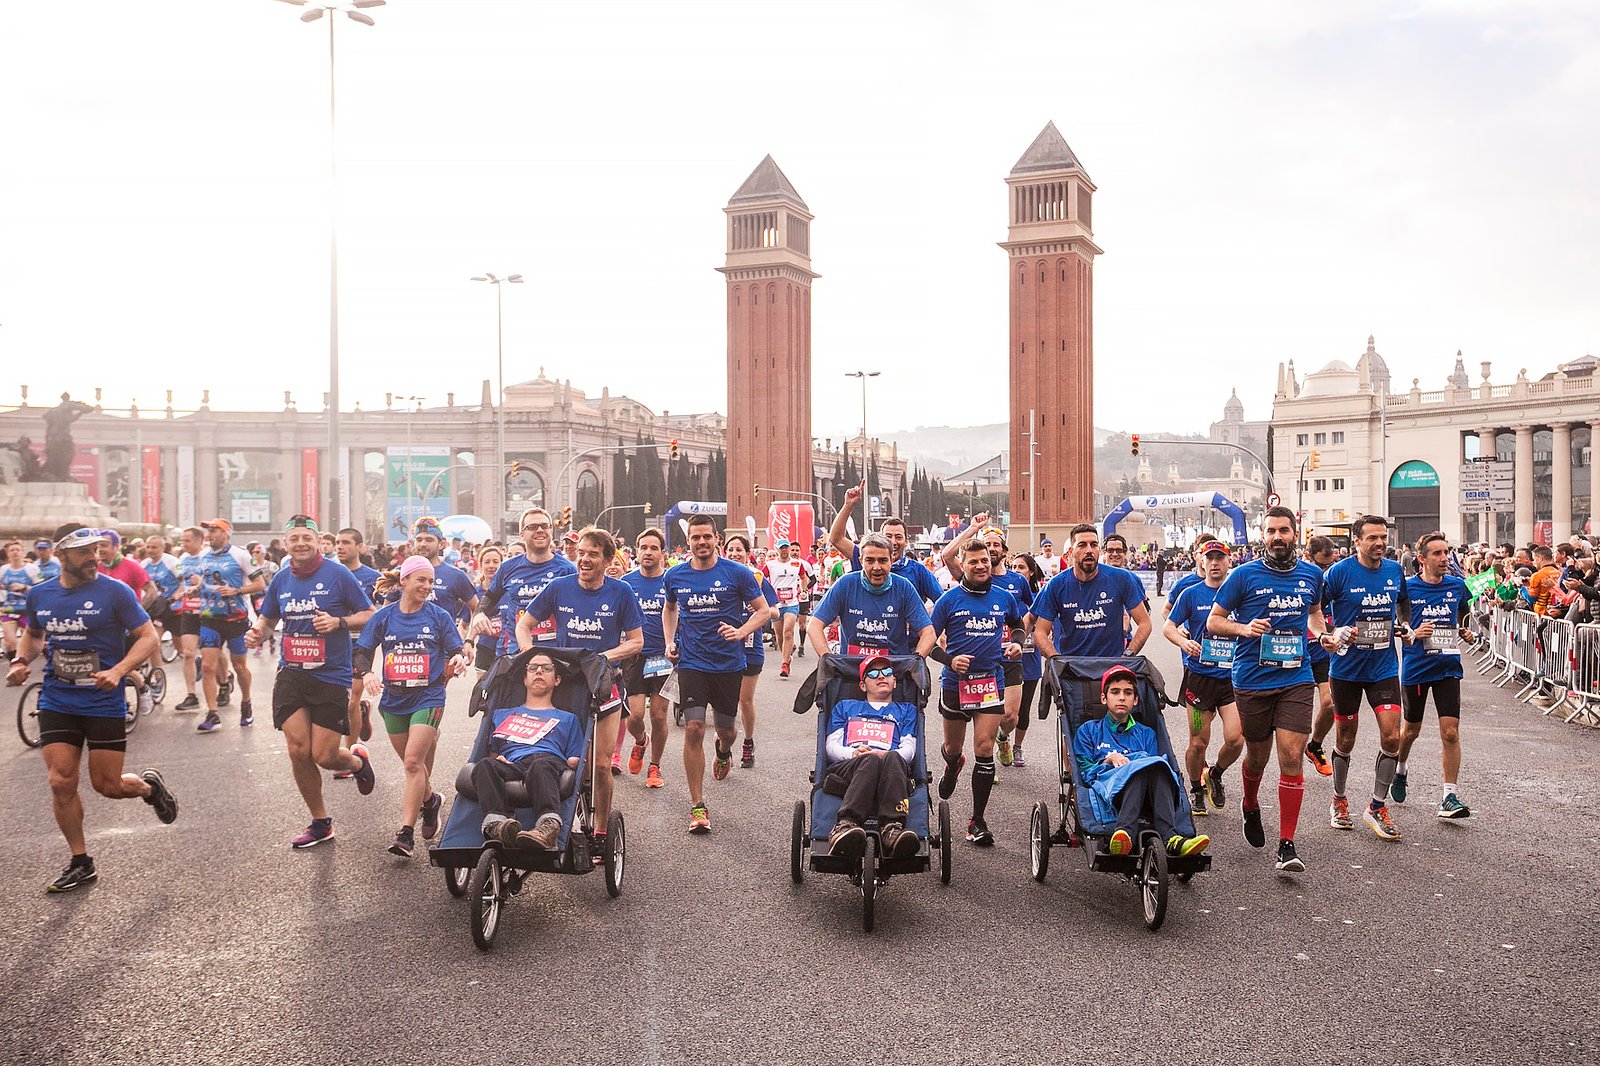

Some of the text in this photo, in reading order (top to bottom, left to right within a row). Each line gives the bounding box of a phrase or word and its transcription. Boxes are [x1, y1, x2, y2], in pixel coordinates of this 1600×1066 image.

[1161, 496, 1194, 505] ZURICH
[1368, 622, 1385, 630] JAVI
[1363, 630, 1388, 638] 15723
[290, 639, 320, 647] SAMUEL
[290, 647, 320, 657] 18170
[860, 647, 881, 656] ALEX
[1272, 645, 1297, 655] 3224
[394, 654, 424, 664] MARÍA
[394, 665, 424, 674] 18168
[964, 682, 996, 694] 16845
[507, 723, 536, 735] 18174
[862, 722, 882, 730] JON
[856, 729, 888, 738] 18176
